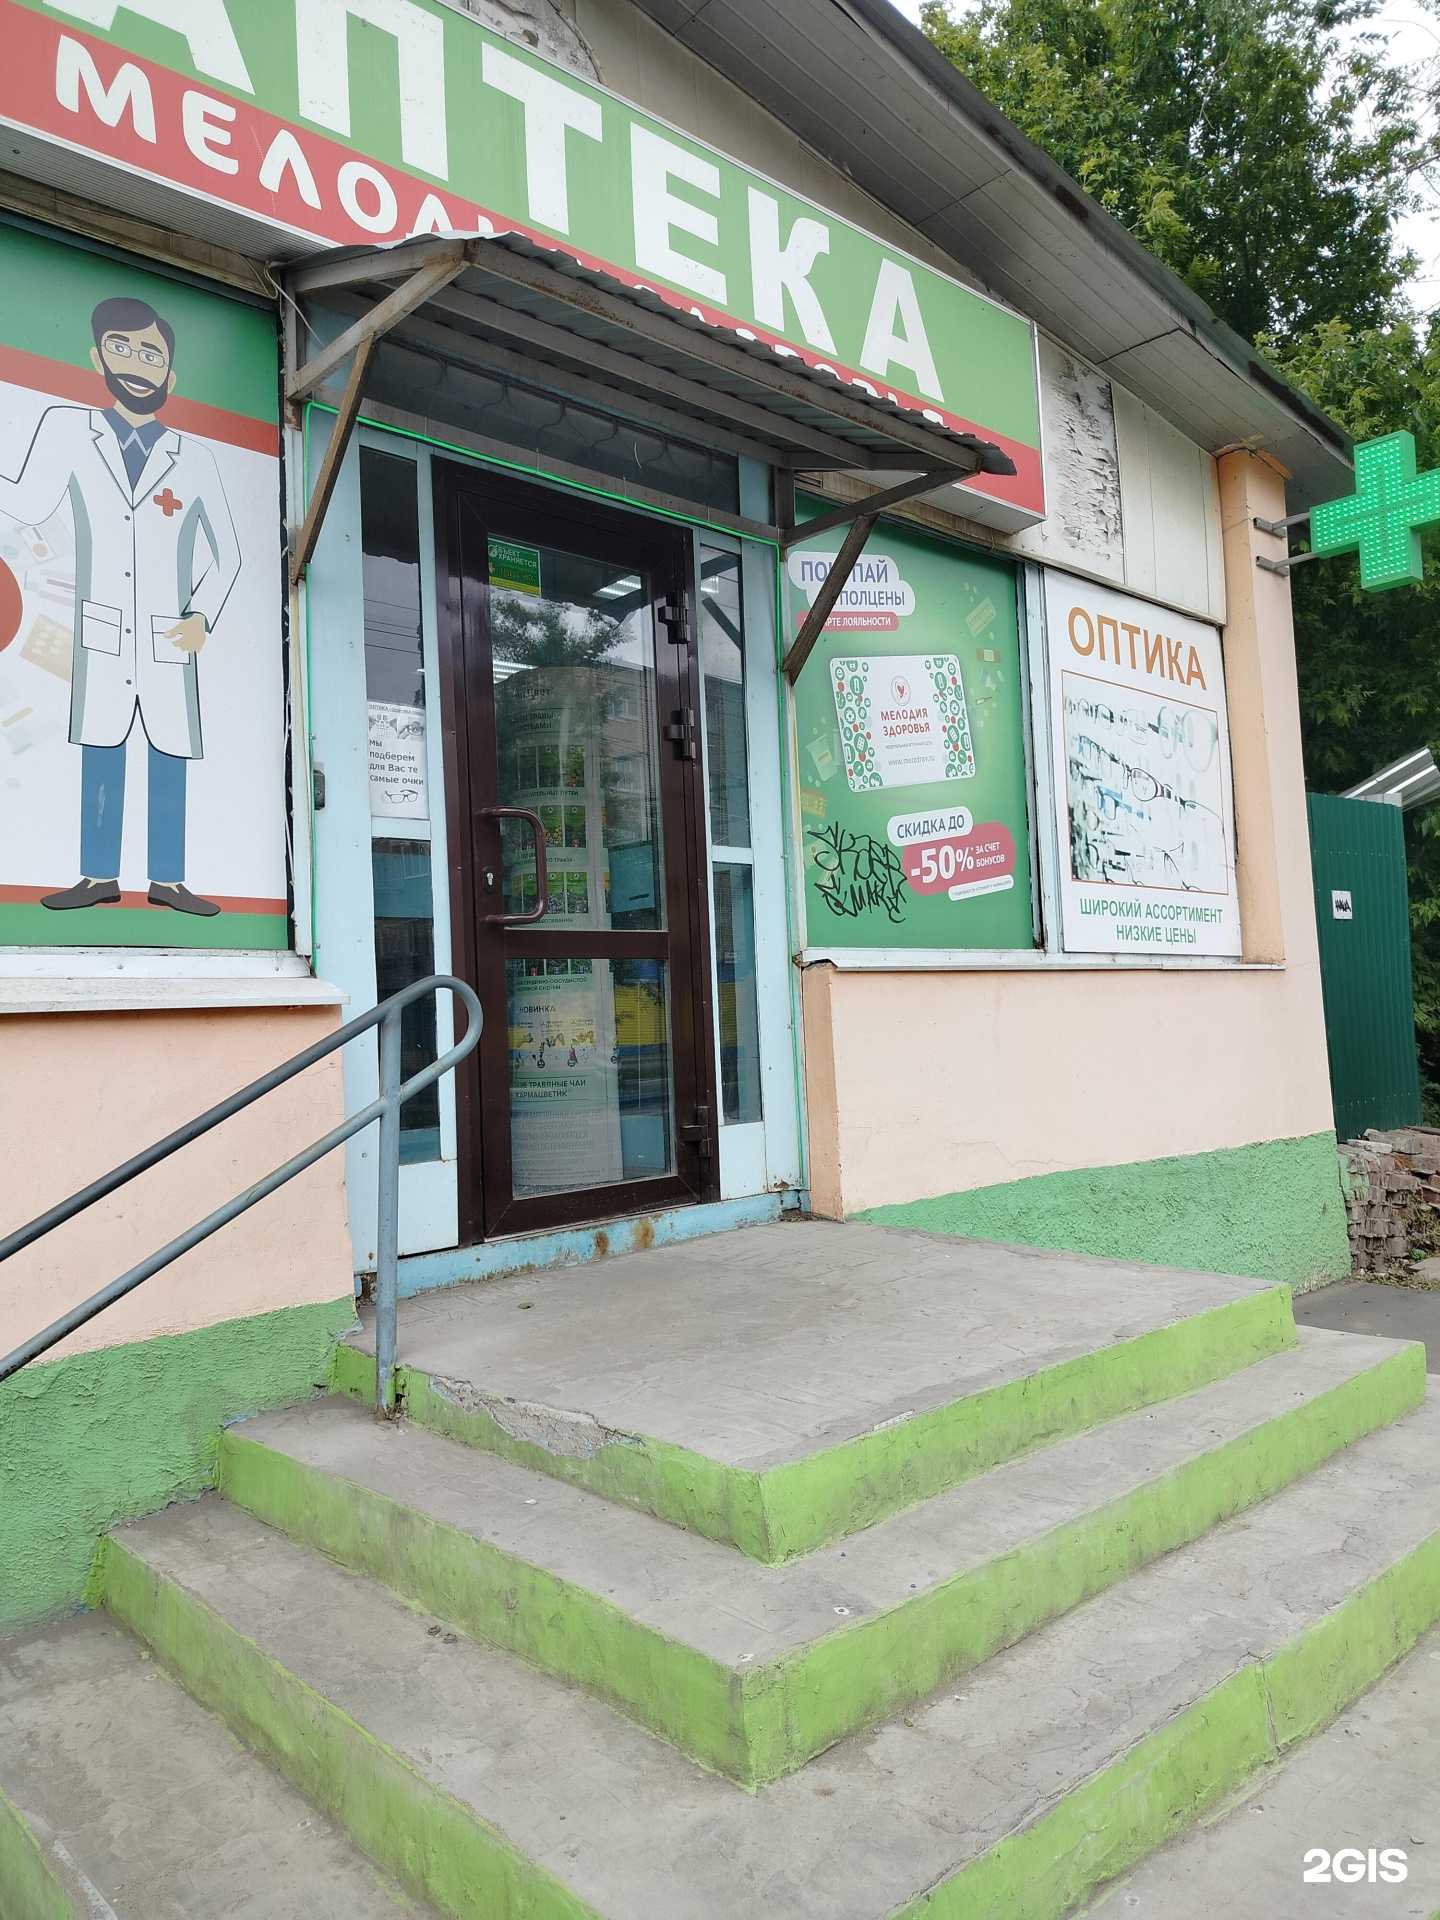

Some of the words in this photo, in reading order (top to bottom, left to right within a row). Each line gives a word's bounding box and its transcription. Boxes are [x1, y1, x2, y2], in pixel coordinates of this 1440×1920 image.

[56, 34, 560, 255] МЕЛОД
[801, 560, 889, 583] ПОПАЙ
[843, 617, 891, 627] ЛОЯЛЬНОСТИ
[1067, 606, 1208, 691] ОПТИКА
[881, 708, 928, 721] МЕЛОДИЯ
[883, 722, 930, 737] ЗДОРОВЬЯ
[370, 763, 386, 771] для
[388, 763, 406, 773] Вас
[408, 766, 419, 774] те
[370, 775, 400, 784] самые
[402, 777, 424, 786] очки
[897, 817, 946, 839] СКИДКА
[948, 814, 965, 832] ДО
[975, 844, 985, 855] ЗА
[985, 841, 1001, 852] СЧЕТ
[976, 854, 1006, 868] БОНУСОВ
[1080, 898, 1142, 918] ШИРОКИЙ
[1145, 903, 1223, 923] АССОРТИМЕНТ
[1116, 924, 1162, 942] НИЗКИЕ
[1166, 927, 1197, 945] ЦЕНЫ
